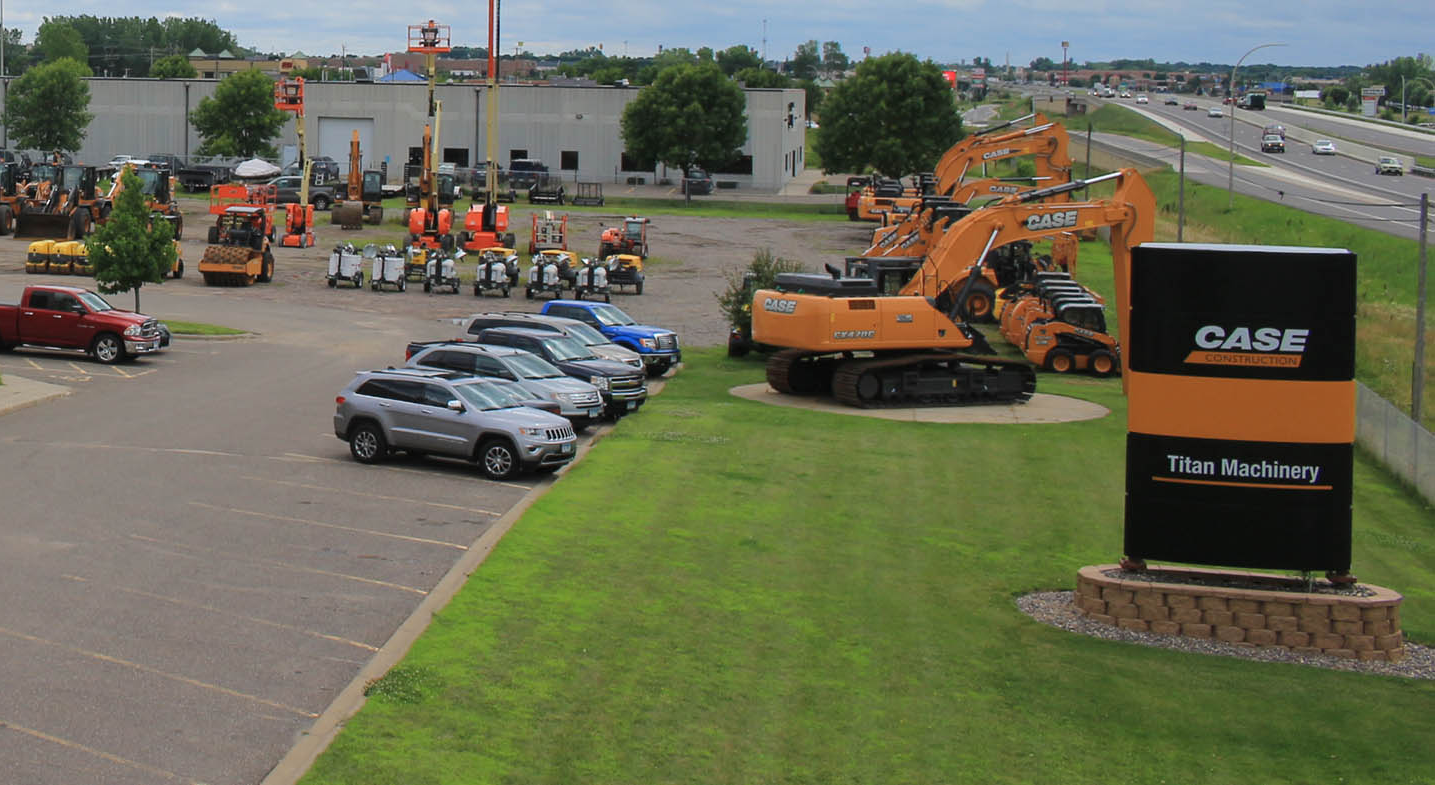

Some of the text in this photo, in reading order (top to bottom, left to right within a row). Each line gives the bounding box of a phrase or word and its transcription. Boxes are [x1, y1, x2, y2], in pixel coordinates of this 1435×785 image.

[983, 148, 1010, 160] CASE
[988, 185, 1019, 194] CASE
[1026, 210, 1078, 231] CASE
[764, 298, 797, 314] CASE
[1195, 325, 1309, 352] CASE
[1204, 353, 1297, 365] CONSTRUCTION
[1167, 454, 1319, 483] Titan Machinery
